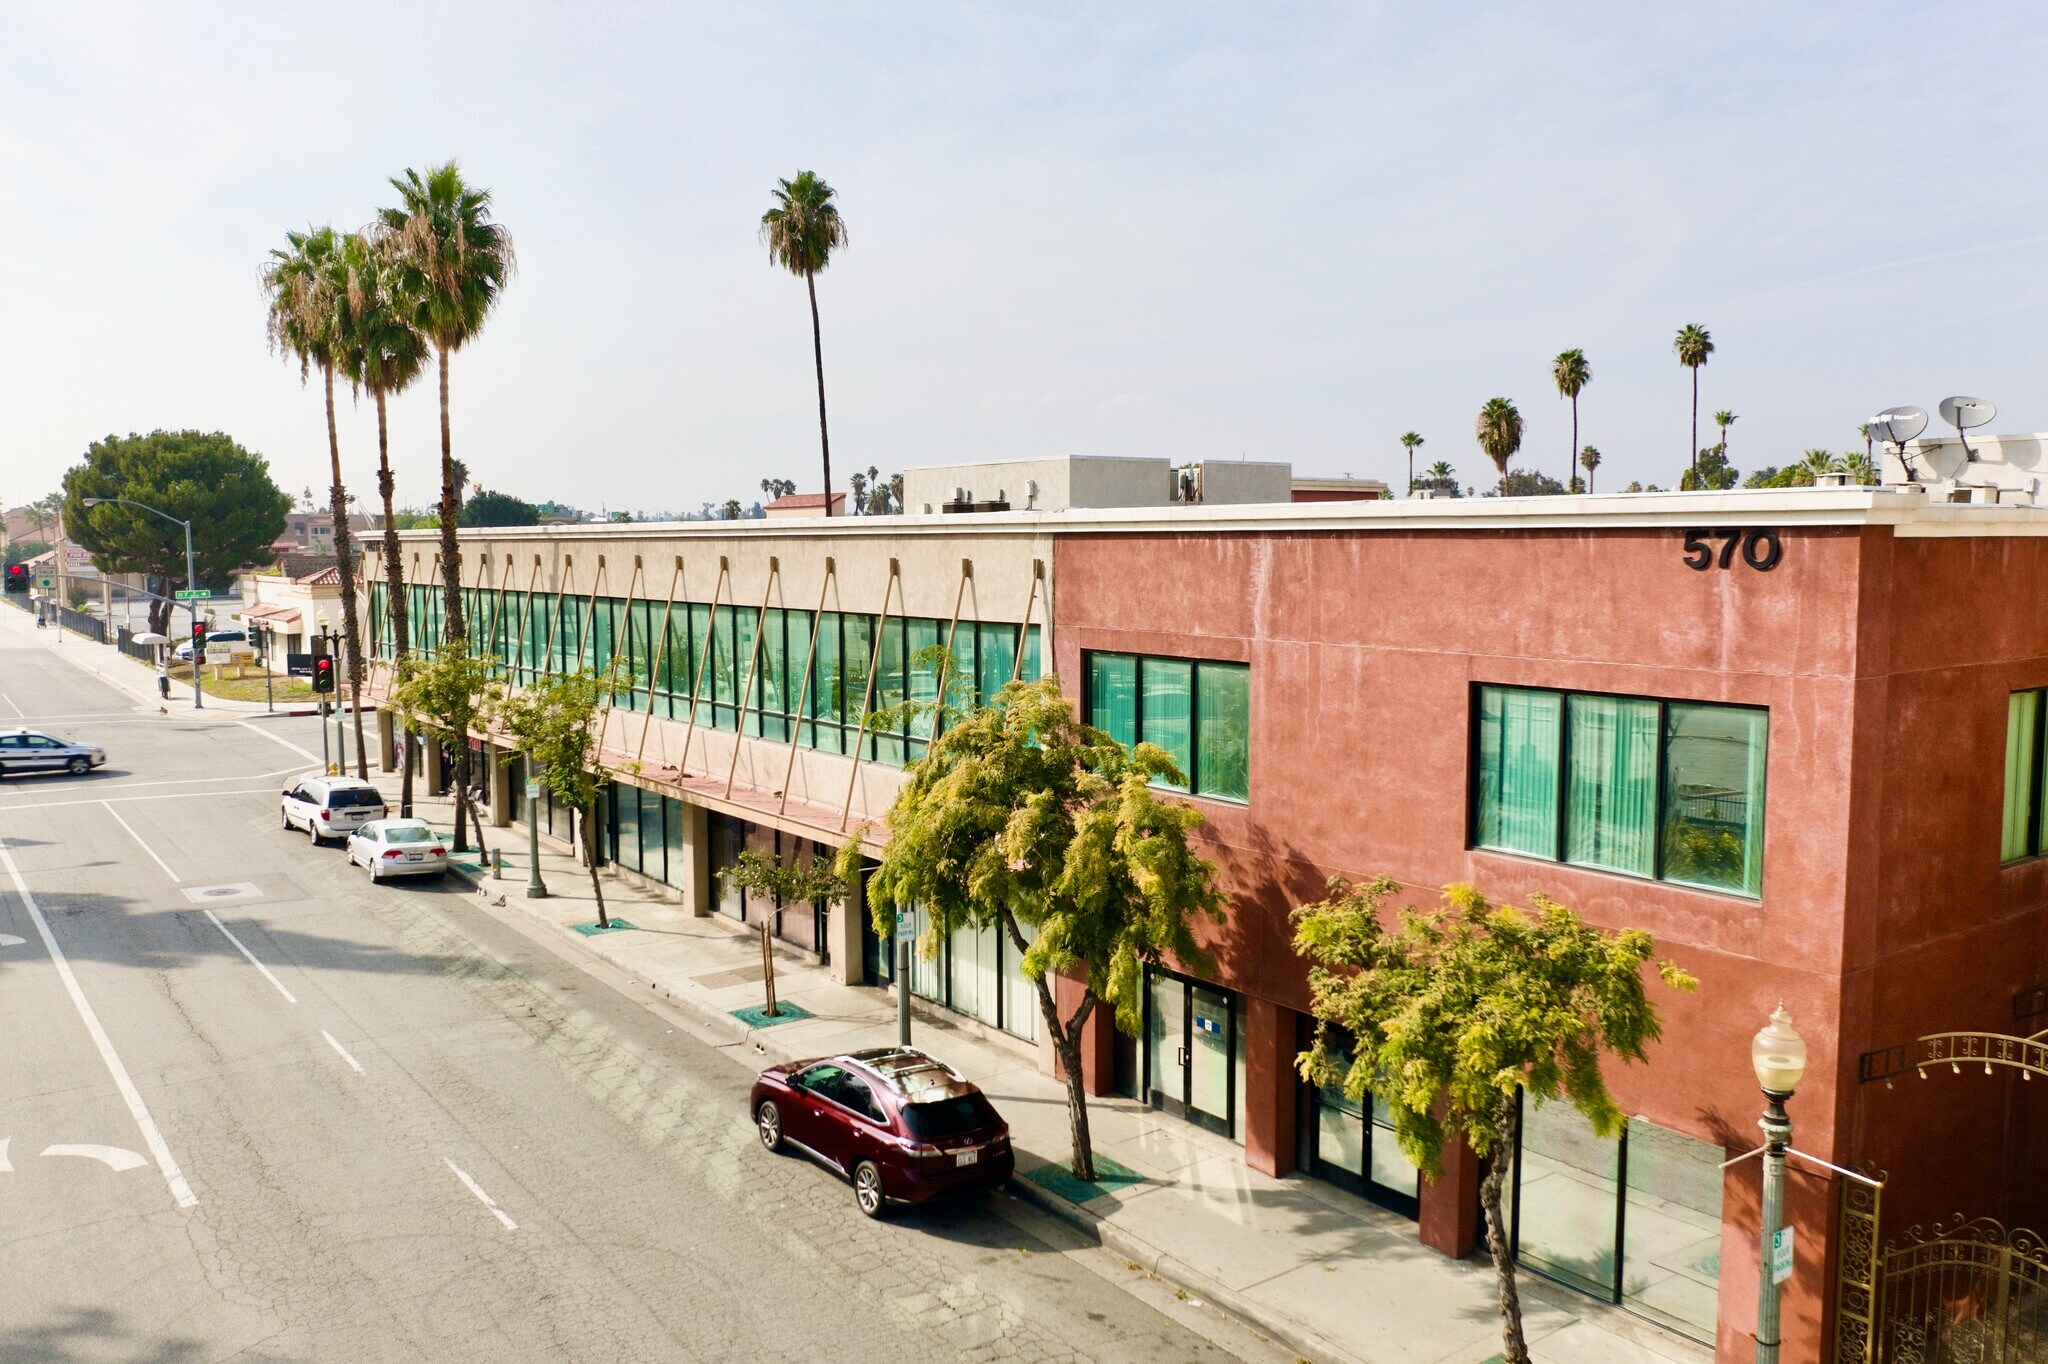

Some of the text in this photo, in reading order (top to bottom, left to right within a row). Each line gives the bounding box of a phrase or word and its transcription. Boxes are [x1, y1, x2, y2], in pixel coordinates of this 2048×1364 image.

[1683, 529, 1780, 570] 570
[898, 929, 914, 937] PARKING
[1777, 1245, 1790, 1257] HOUR
[1774, 1259, 1792, 1271] PARKING
